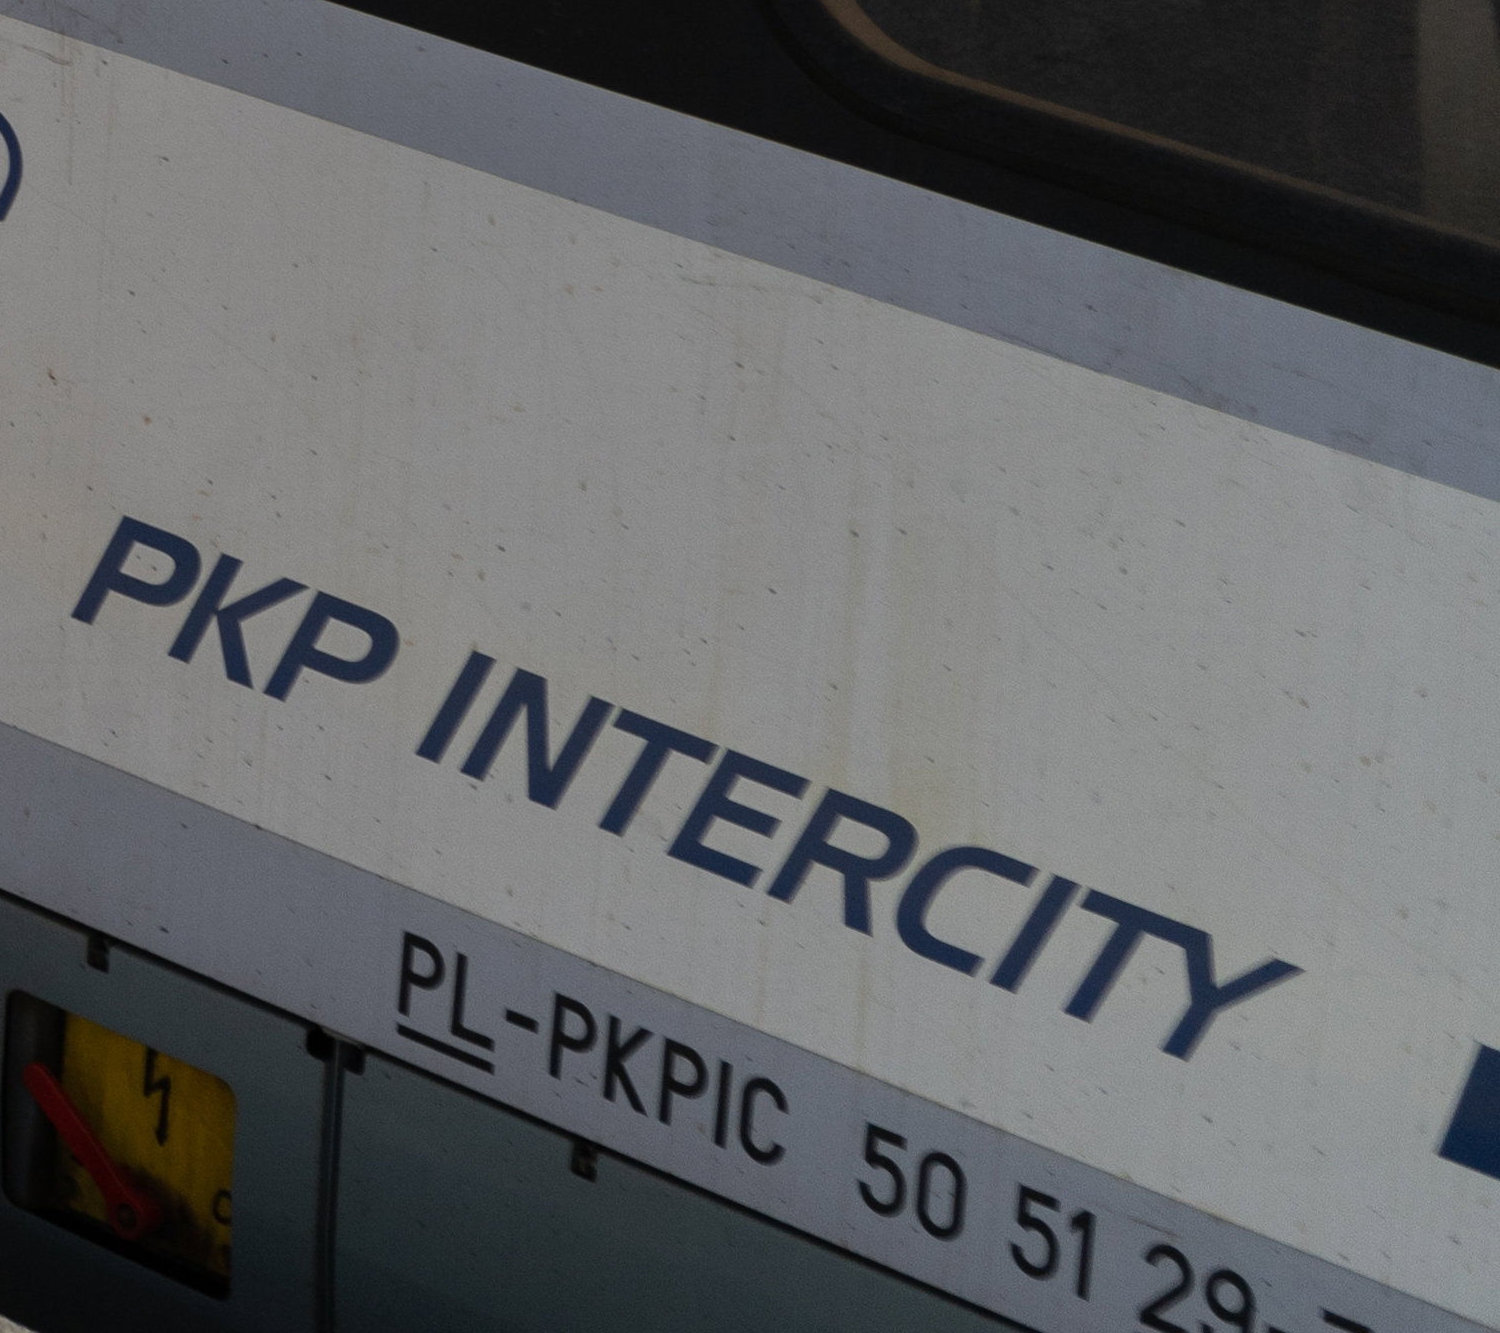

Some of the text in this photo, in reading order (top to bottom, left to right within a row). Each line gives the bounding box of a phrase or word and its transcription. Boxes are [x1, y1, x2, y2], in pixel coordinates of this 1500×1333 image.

[71, 515, 1302, 1061] PKP INTERCITY
[397, 930, 788, 1167] PL-PKPIC
[856, 1122, 966, 1241] 50
[1010, 1182, 1095, 1300] 51
